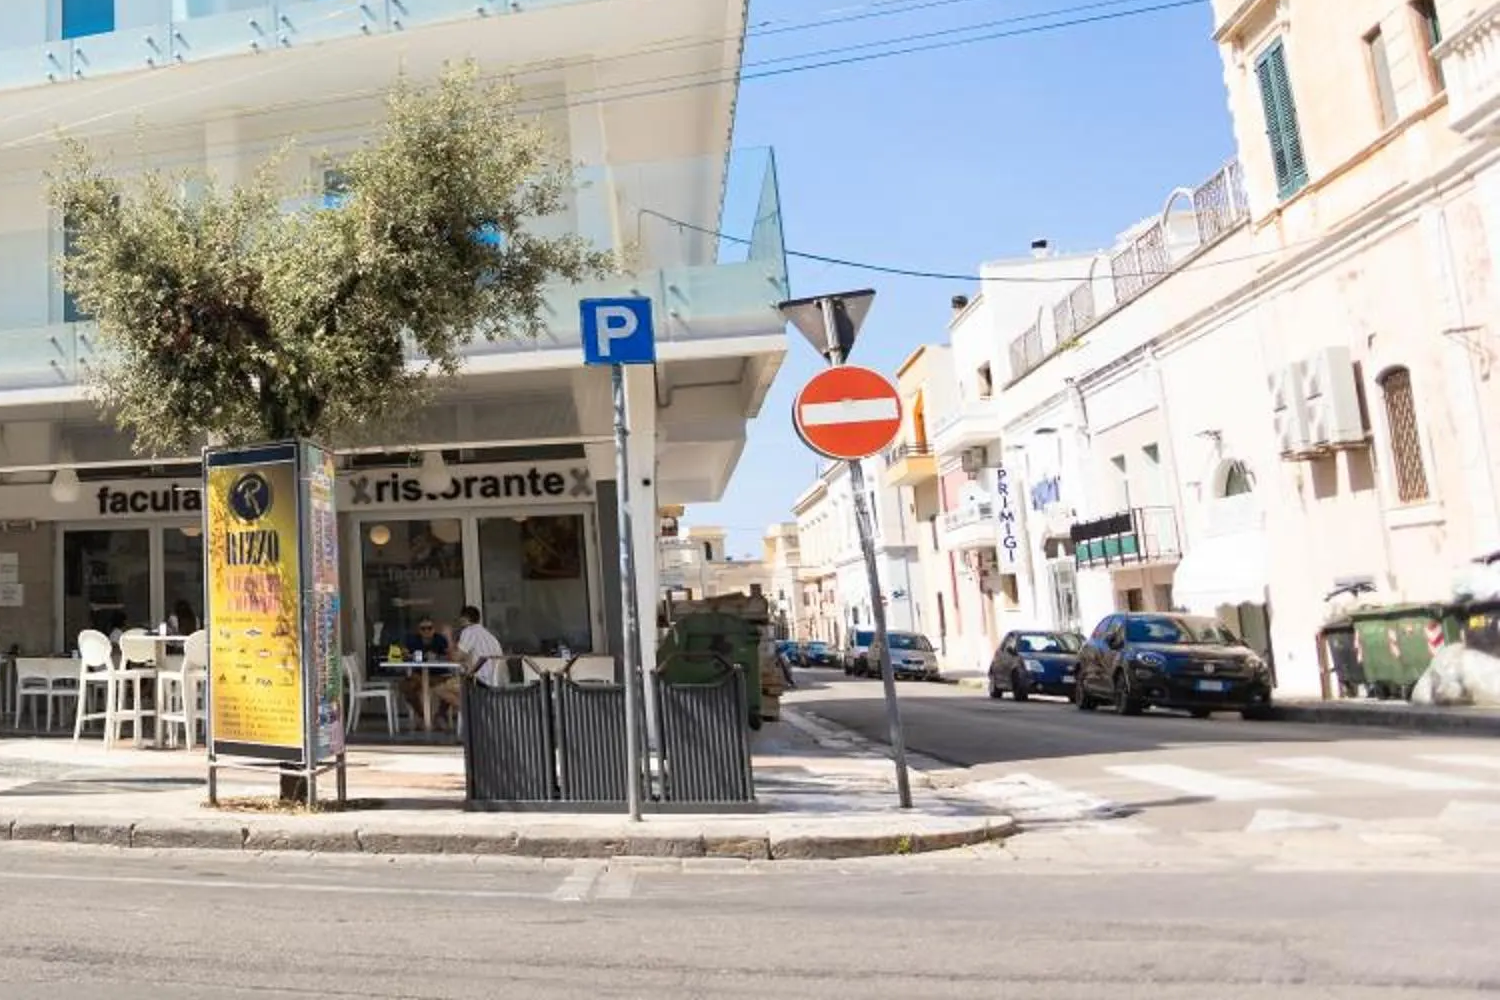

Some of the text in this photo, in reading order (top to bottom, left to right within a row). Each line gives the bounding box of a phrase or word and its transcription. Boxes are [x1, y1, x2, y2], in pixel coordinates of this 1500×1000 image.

[595, 304, 638, 357] P
[375, 467, 566, 503] risorante
[997, 469, 1017, 562] PRIMIGI
